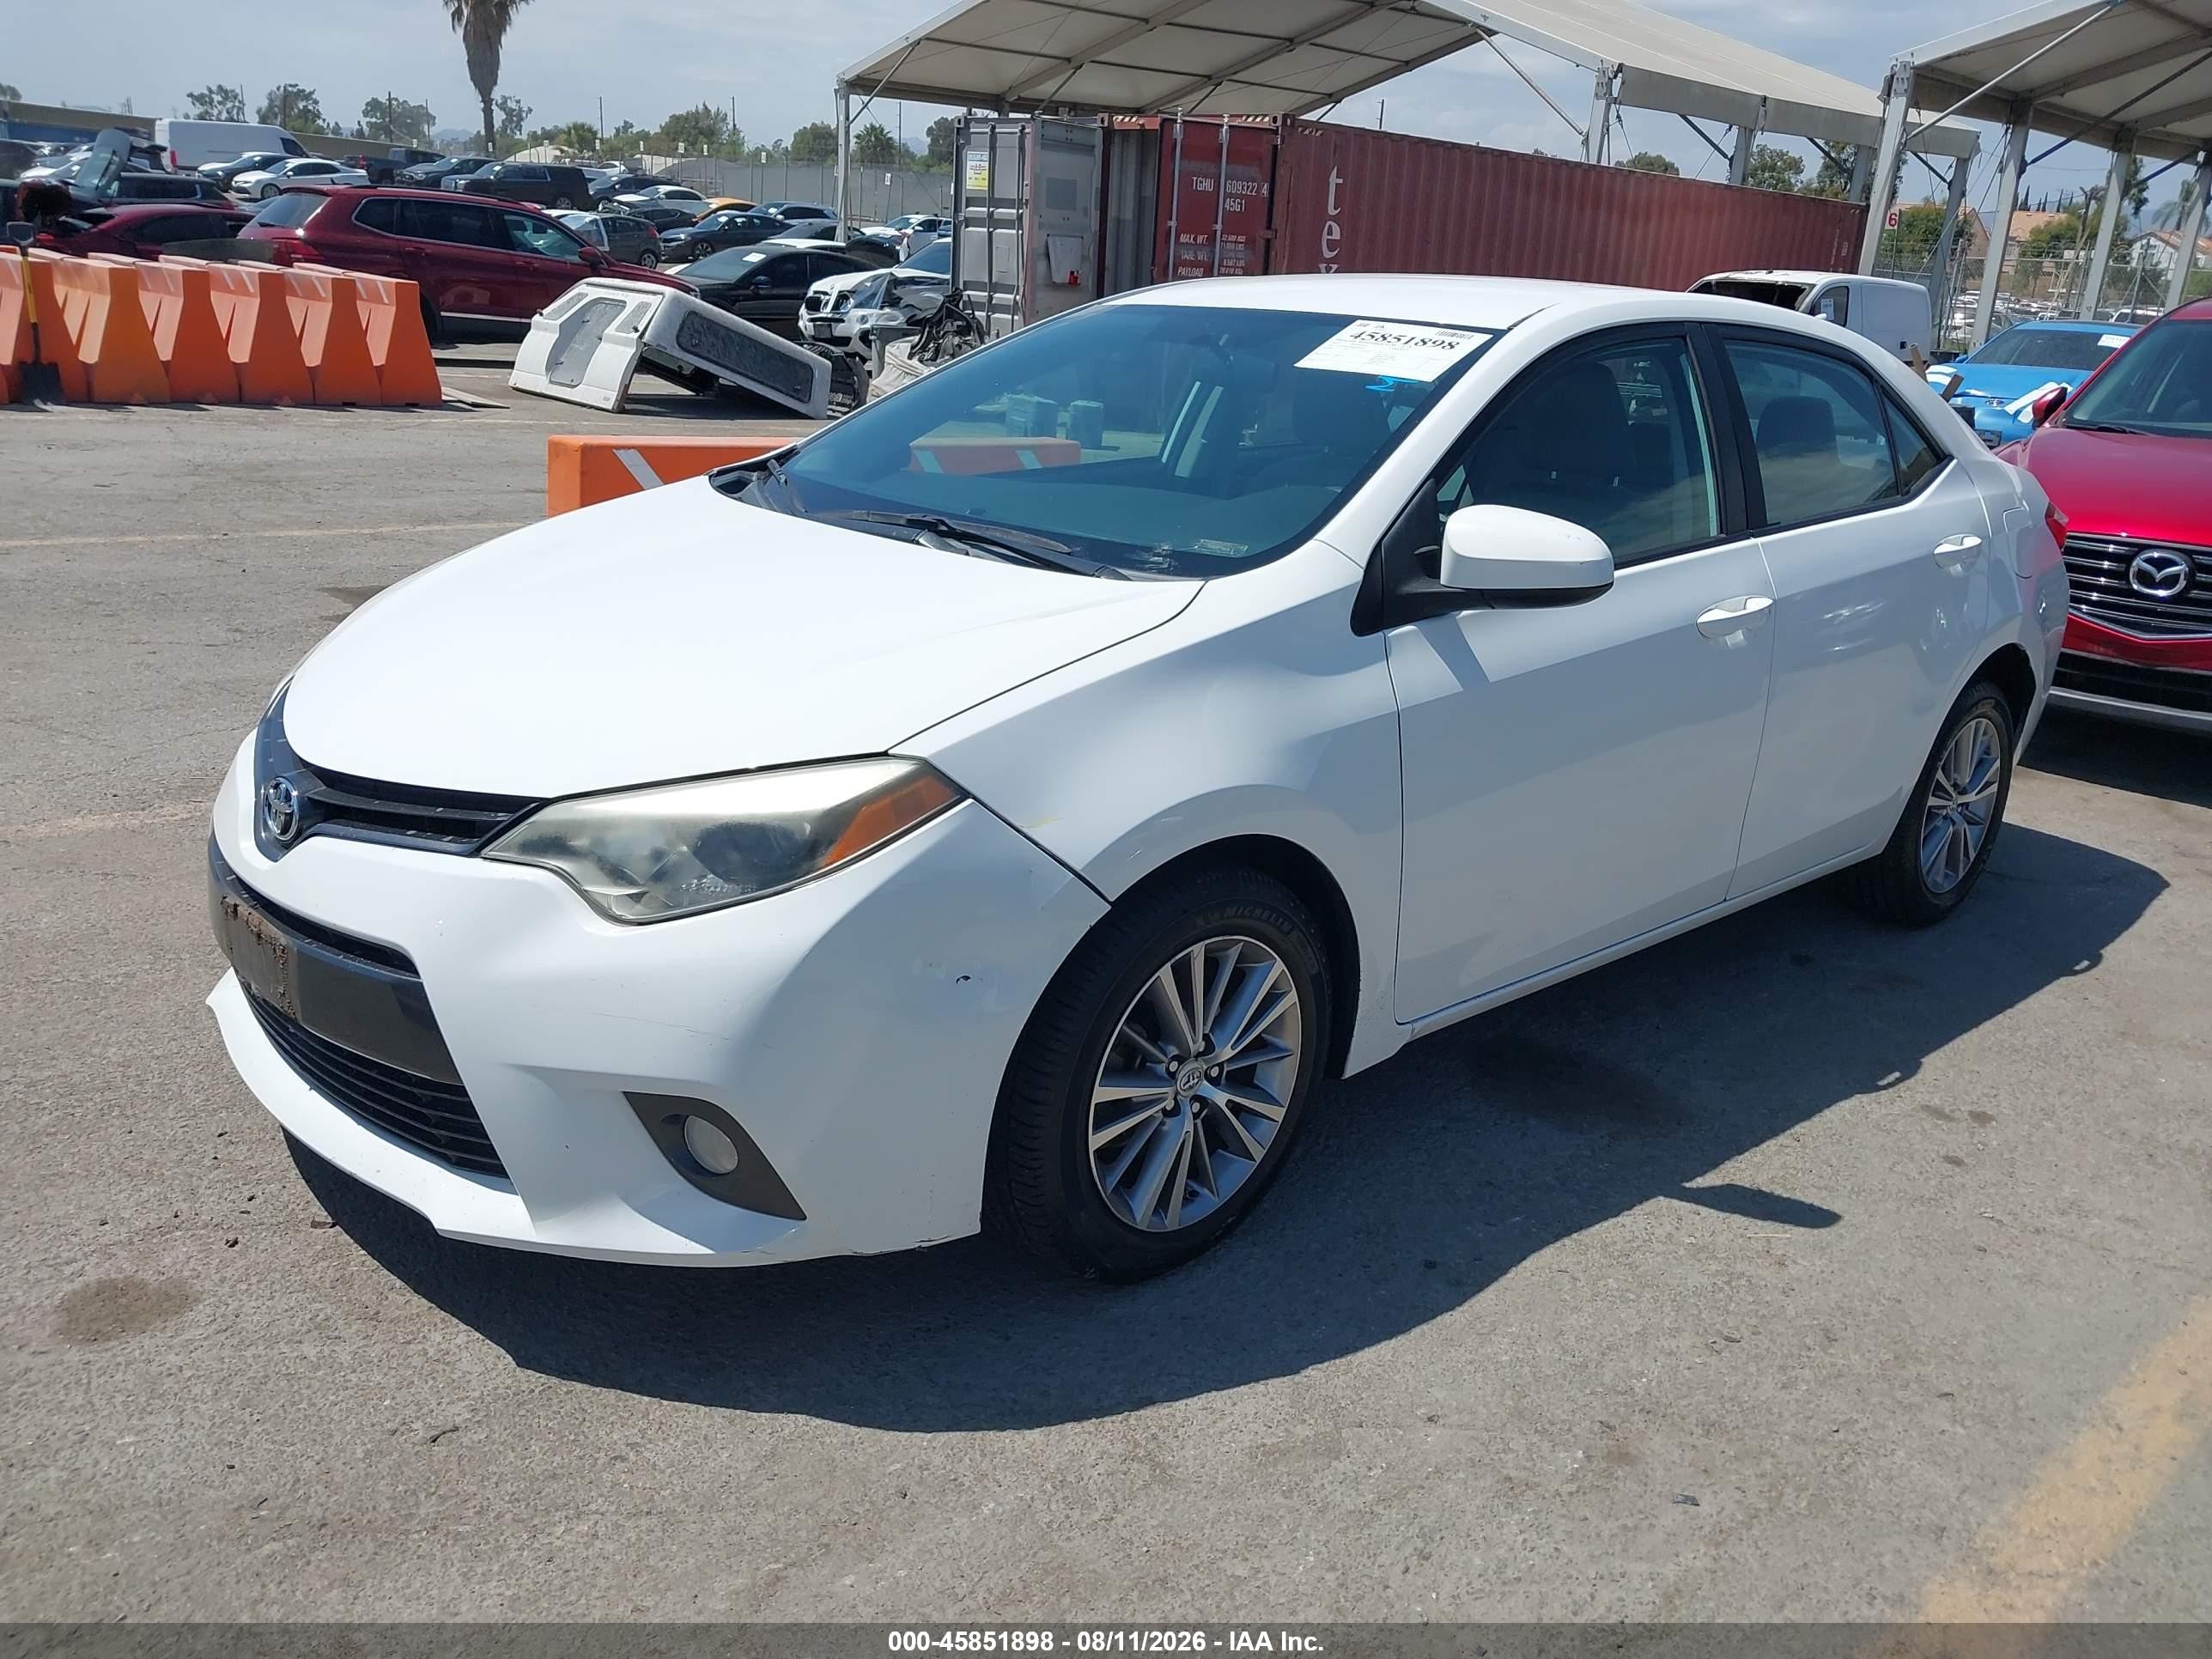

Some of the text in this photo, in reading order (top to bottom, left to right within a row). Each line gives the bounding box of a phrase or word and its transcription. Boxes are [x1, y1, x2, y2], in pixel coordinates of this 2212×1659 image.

[1192, 176, 1268, 198] TGHU 609322 4
[1224, 198, 1246, 213] 45G1
[1319, 165, 1344, 273] te
[1888, 213, 1898, 228] 6
[1197, 234, 1209, 246] WT.
[1177, 266, 1204, 277] PAYLOAD
[1349, 330, 1461, 351] 45851898
[1223, 906, 1293, 936] MICHELIN
